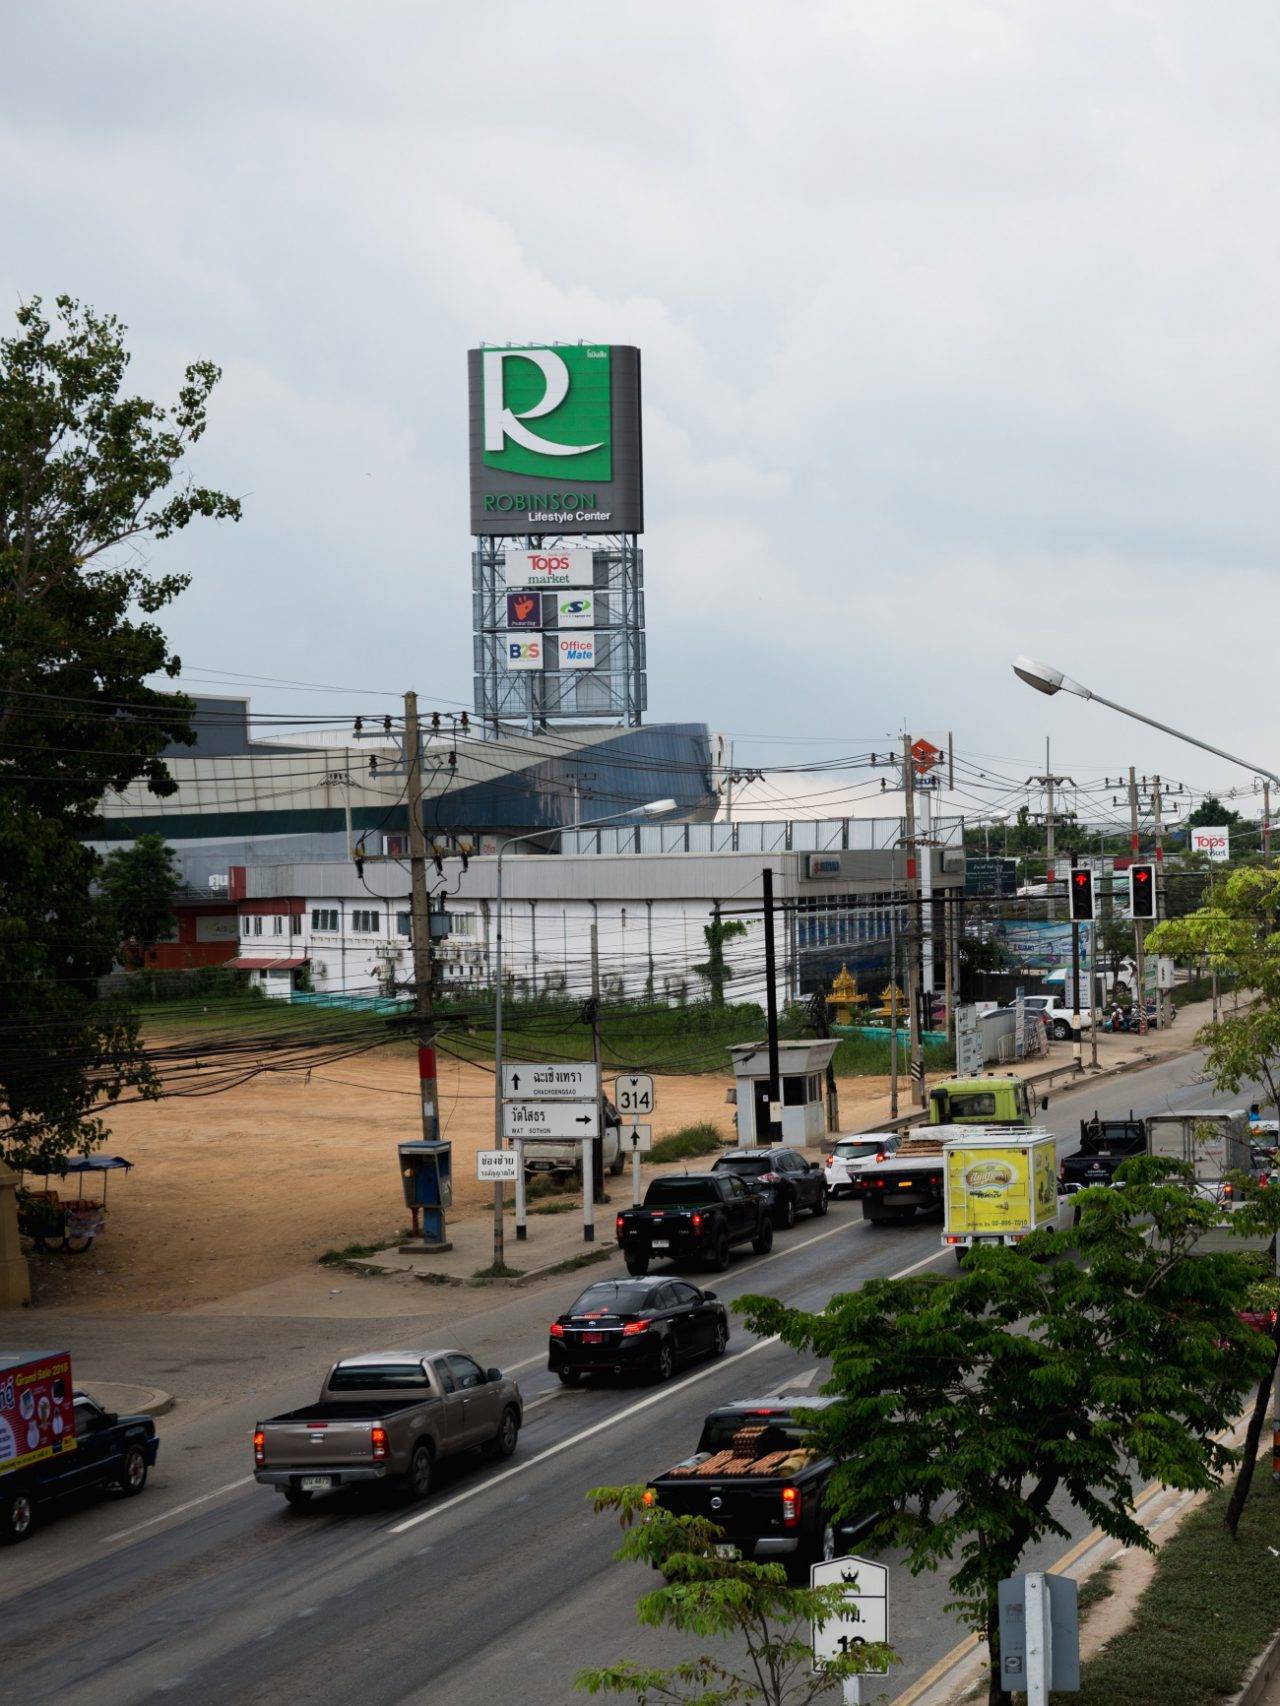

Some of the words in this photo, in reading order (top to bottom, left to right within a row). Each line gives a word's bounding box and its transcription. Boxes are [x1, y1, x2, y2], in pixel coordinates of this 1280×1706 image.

[483, 492, 596, 512] ROBINSON
[528, 512, 573, 523] Lifestyle
[575, 511, 612, 521] Center
[528, 554, 570, 575] Tops
[528, 573, 569, 584] market
[510, 643, 540, 659] B2S
[560, 641, 593, 651] Office
[567, 651, 593, 660] Mate
[1194, 836, 1226, 848] Tops
[533, 1067, 582, 1083] ฉะเชิงเทรา
[620, 1092, 650, 1109] 314
[511, 1107, 546, 1122] วัดโสธร
